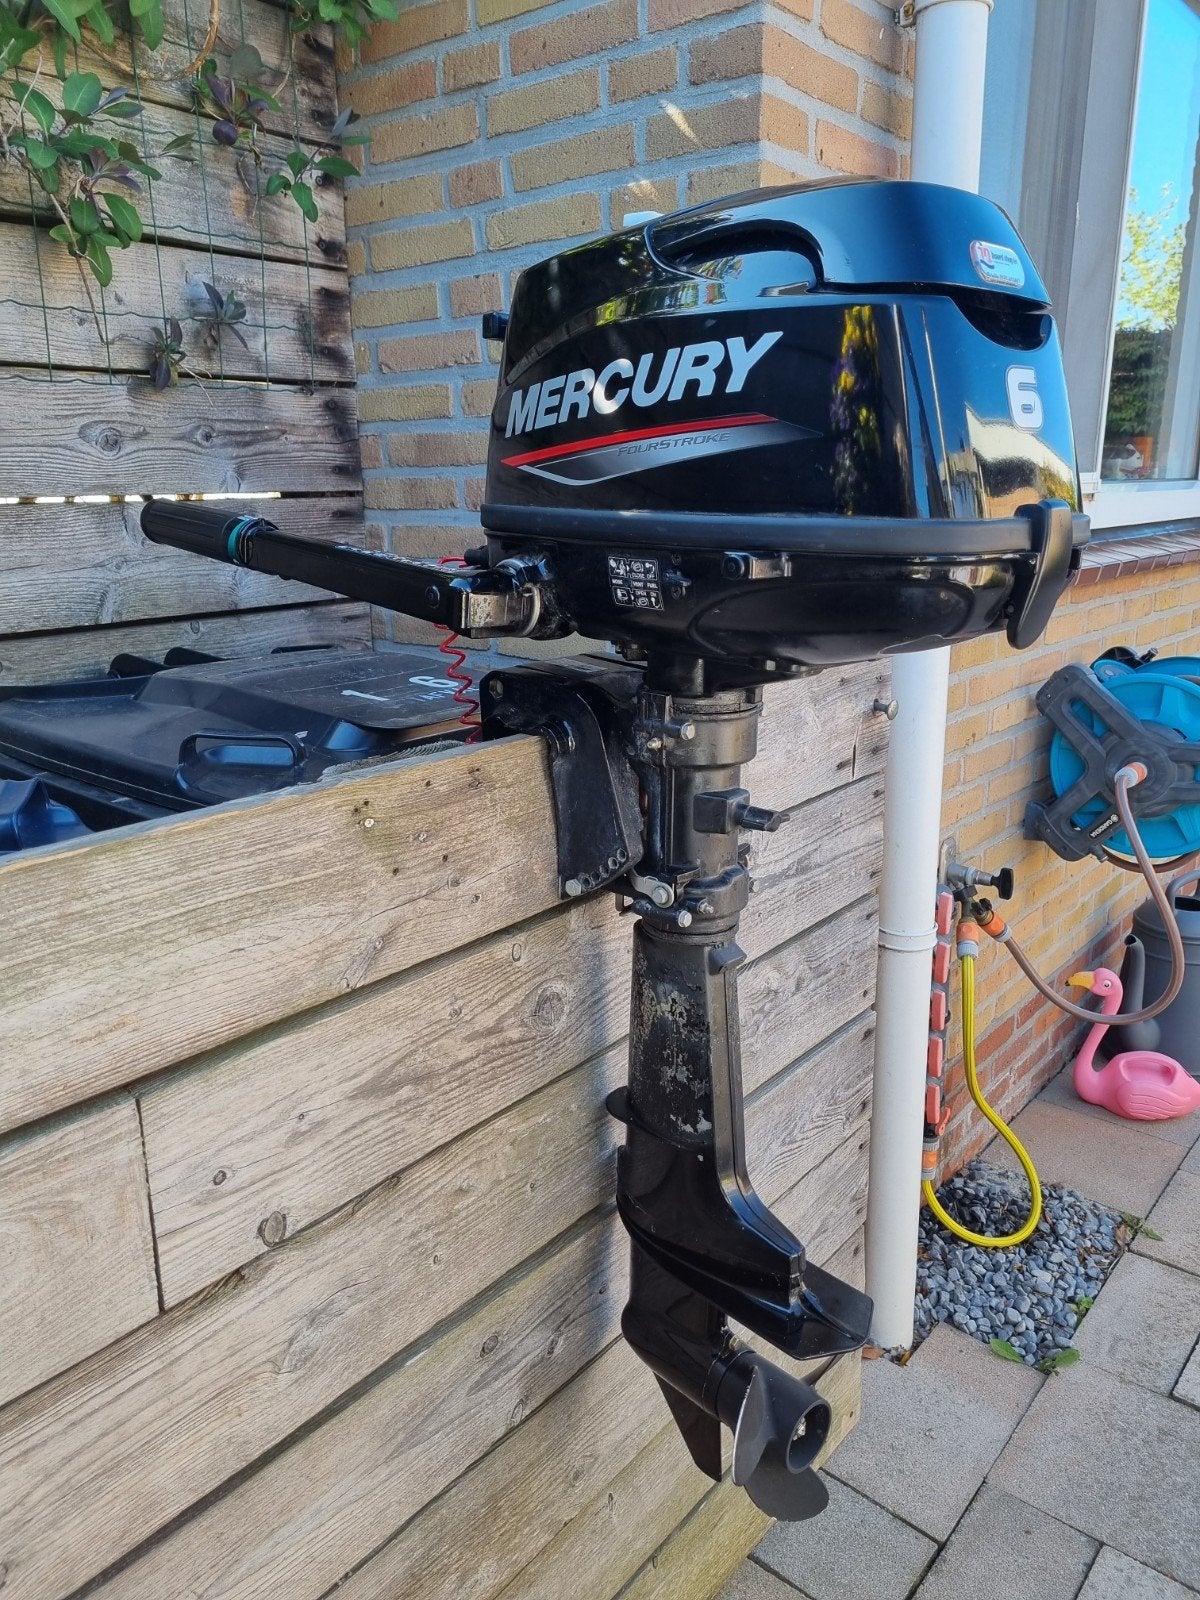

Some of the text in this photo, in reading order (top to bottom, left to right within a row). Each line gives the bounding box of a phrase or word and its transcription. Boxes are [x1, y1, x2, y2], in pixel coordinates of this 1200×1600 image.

[505, 331, 784, 438] MERCURY
[1005, 365, 1044, 433] 6
[617, 432, 731, 457] FOURSTROKE
[408, 675, 459, 688] 6
[1090, 819, 1113, 837] GARDENA
